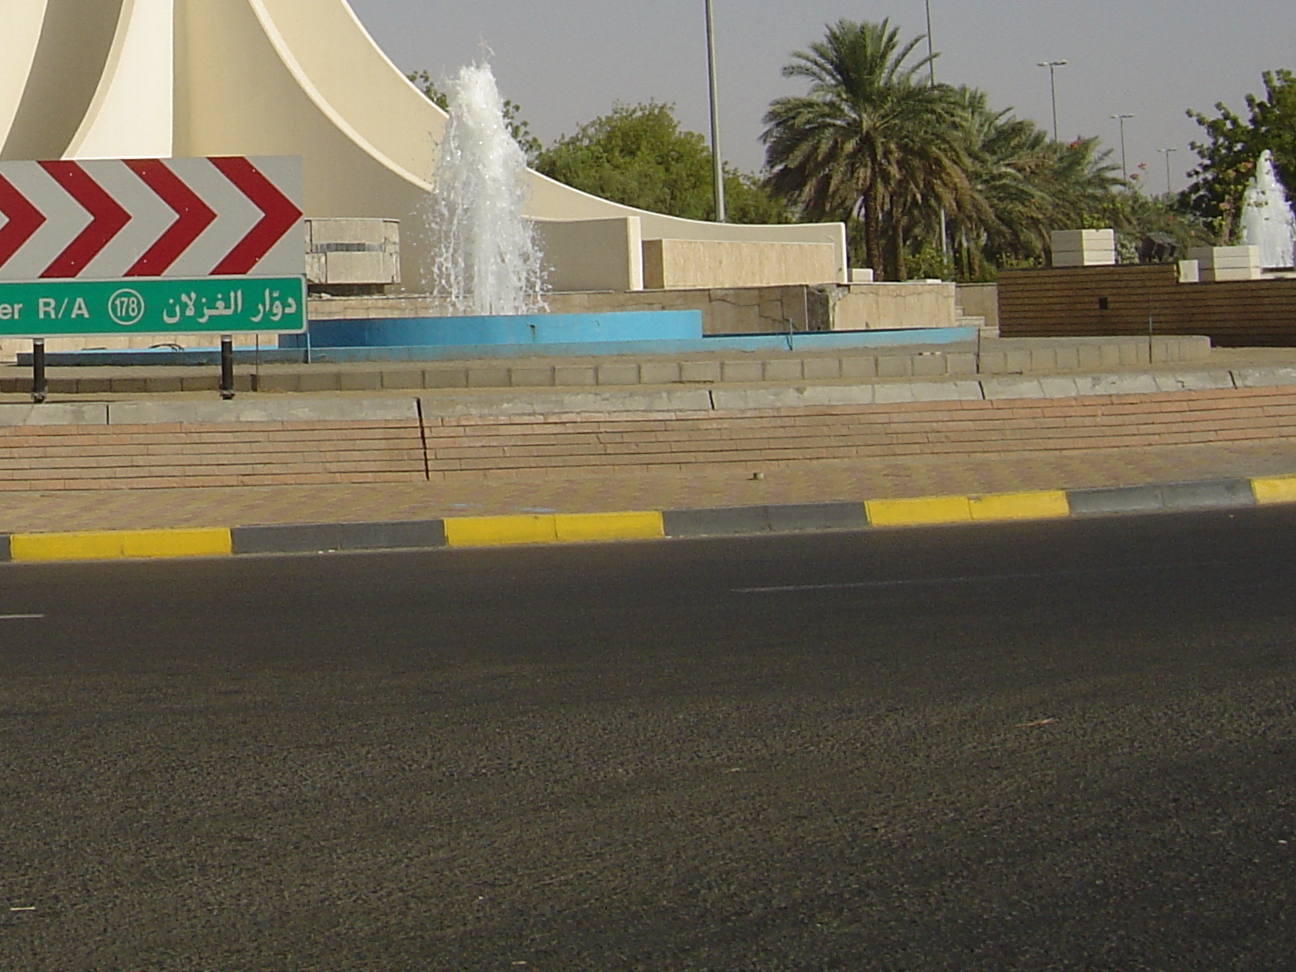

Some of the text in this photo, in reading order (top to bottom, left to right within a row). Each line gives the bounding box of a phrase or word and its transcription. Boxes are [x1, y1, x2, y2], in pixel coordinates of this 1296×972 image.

[38, 297, 90, 319] R/A
[114, 297, 138, 318] 178
[162, 289, 242, 324] الغزلان
